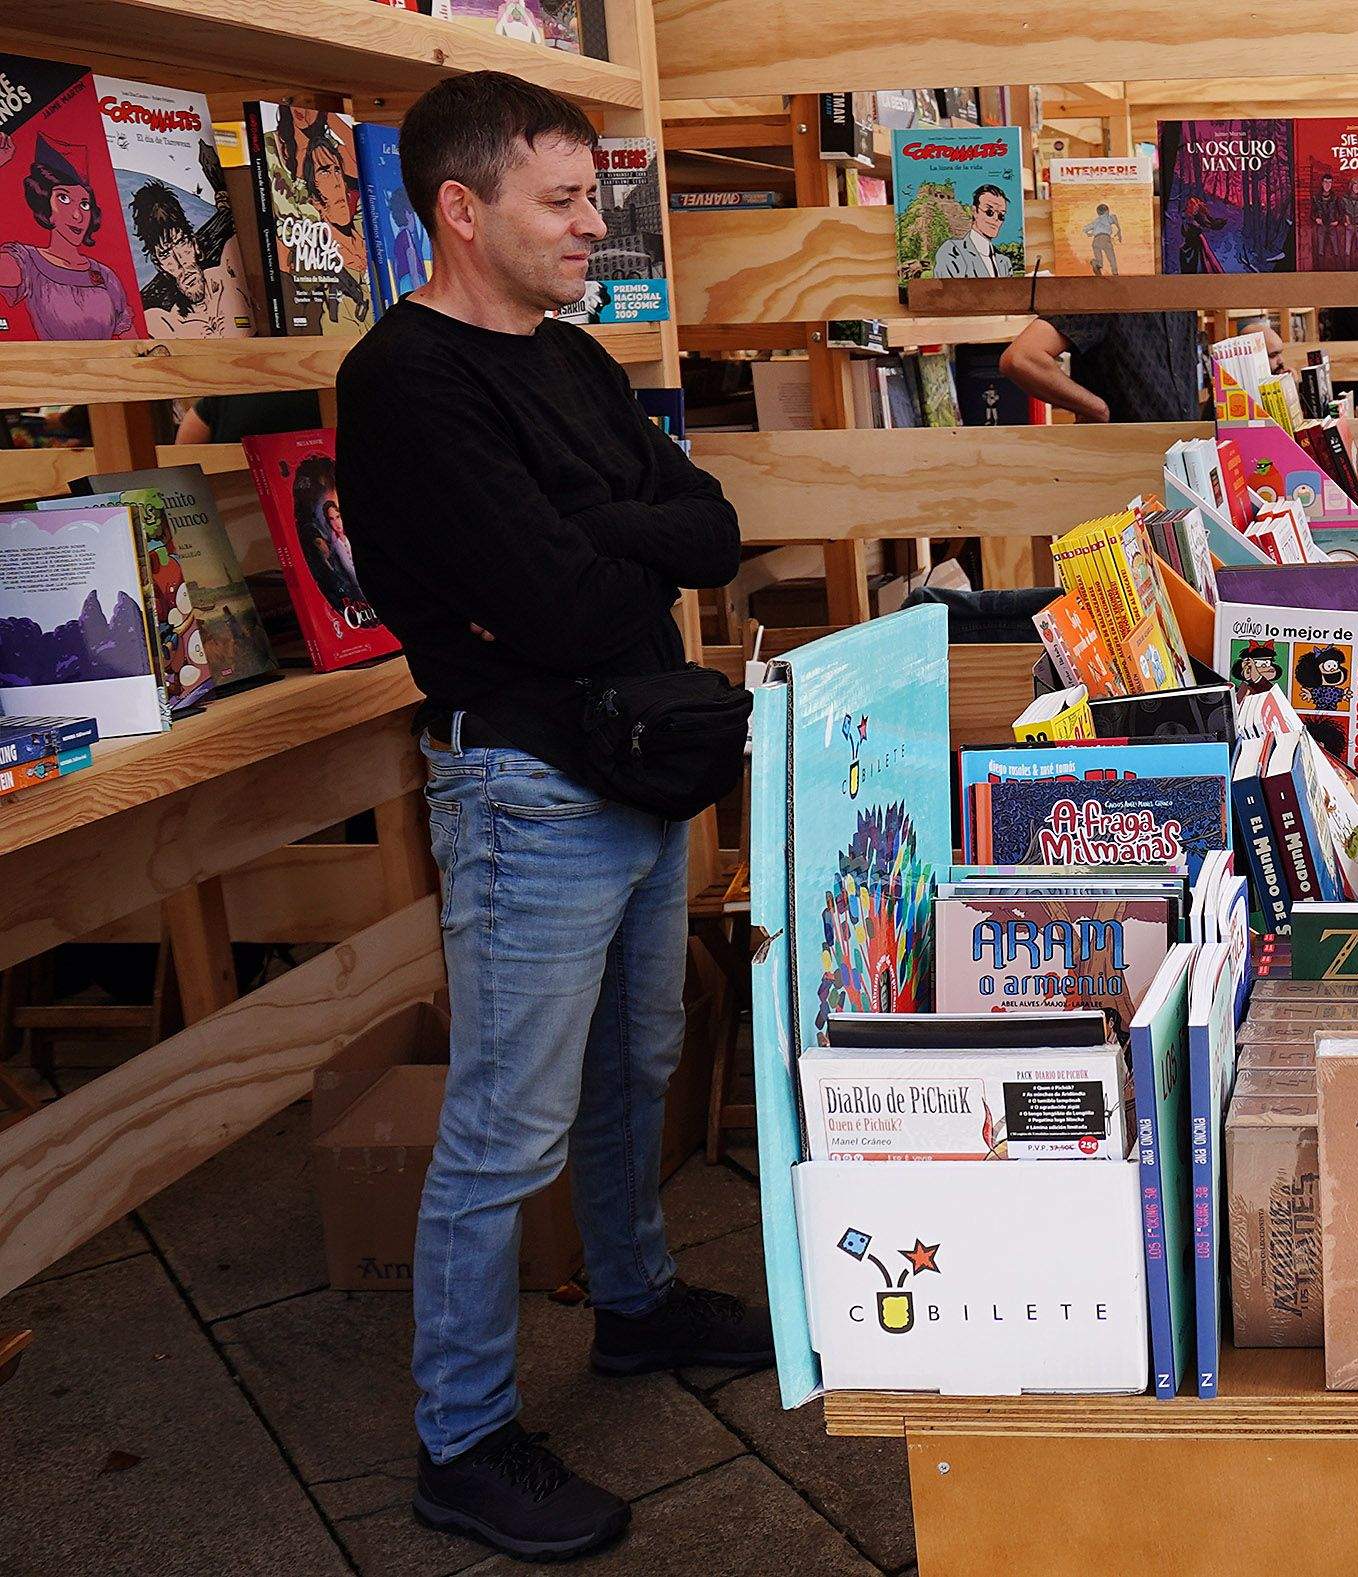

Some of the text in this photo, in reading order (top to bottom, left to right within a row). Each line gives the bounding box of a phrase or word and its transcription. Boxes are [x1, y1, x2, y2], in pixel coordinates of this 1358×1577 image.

[833, 92, 846, 124] TMAN
[1187, 140, 1275, 159] UN OSCURO
[1060, 165, 1137, 177] INTEMPERIE
[1202, 157, 1262, 172] MANTO
[1340, 158, 1358, 170] 20
[281, 217, 332, 250] CORTO
[613, 285, 648, 294] PREMIO
[614, 292, 661, 301] NACIONAL
[614, 301, 627, 309] DE
[615, 310, 638, 319] 2009
[168, 512, 208, 534] junco
[1265, 624, 1280, 637] lo
[1283, 626, 1330, 642] mejor
[1333, 627, 1353, 640] de
[988, 760, 1006, 774] diego
[1009, 763, 1031, 776] rosales
[1032, 763, 1038, 776] &
[1056, 760, 1076, 774] tomás
[1045, 799, 1159, 843] A fraga
[1250, 817, 1262, 832] EL
[1282, 812, 1310, 893] EL MUNDO
[1253, 838, 1279, 897] MUNDO
[1272, 902, 1285, 921] DE
[972, 919, 1131, 970] ARAM
[979, 971, 1123, 996] o armenio
[1017, 1071, 1032, 1080] PACK
[1034, 1070, 1056, 1079] DIARIO
[1057, 1070, 1065, 1079] DE
[887, 1086, 906, 1114] de
[828, 1118, 853, 1131] Quen
[856, 1117, 862, 1131] é
[831, 1137, 892, 1146] Manel Cráneo
[1081, 1141, 1098, 1150] 25€
